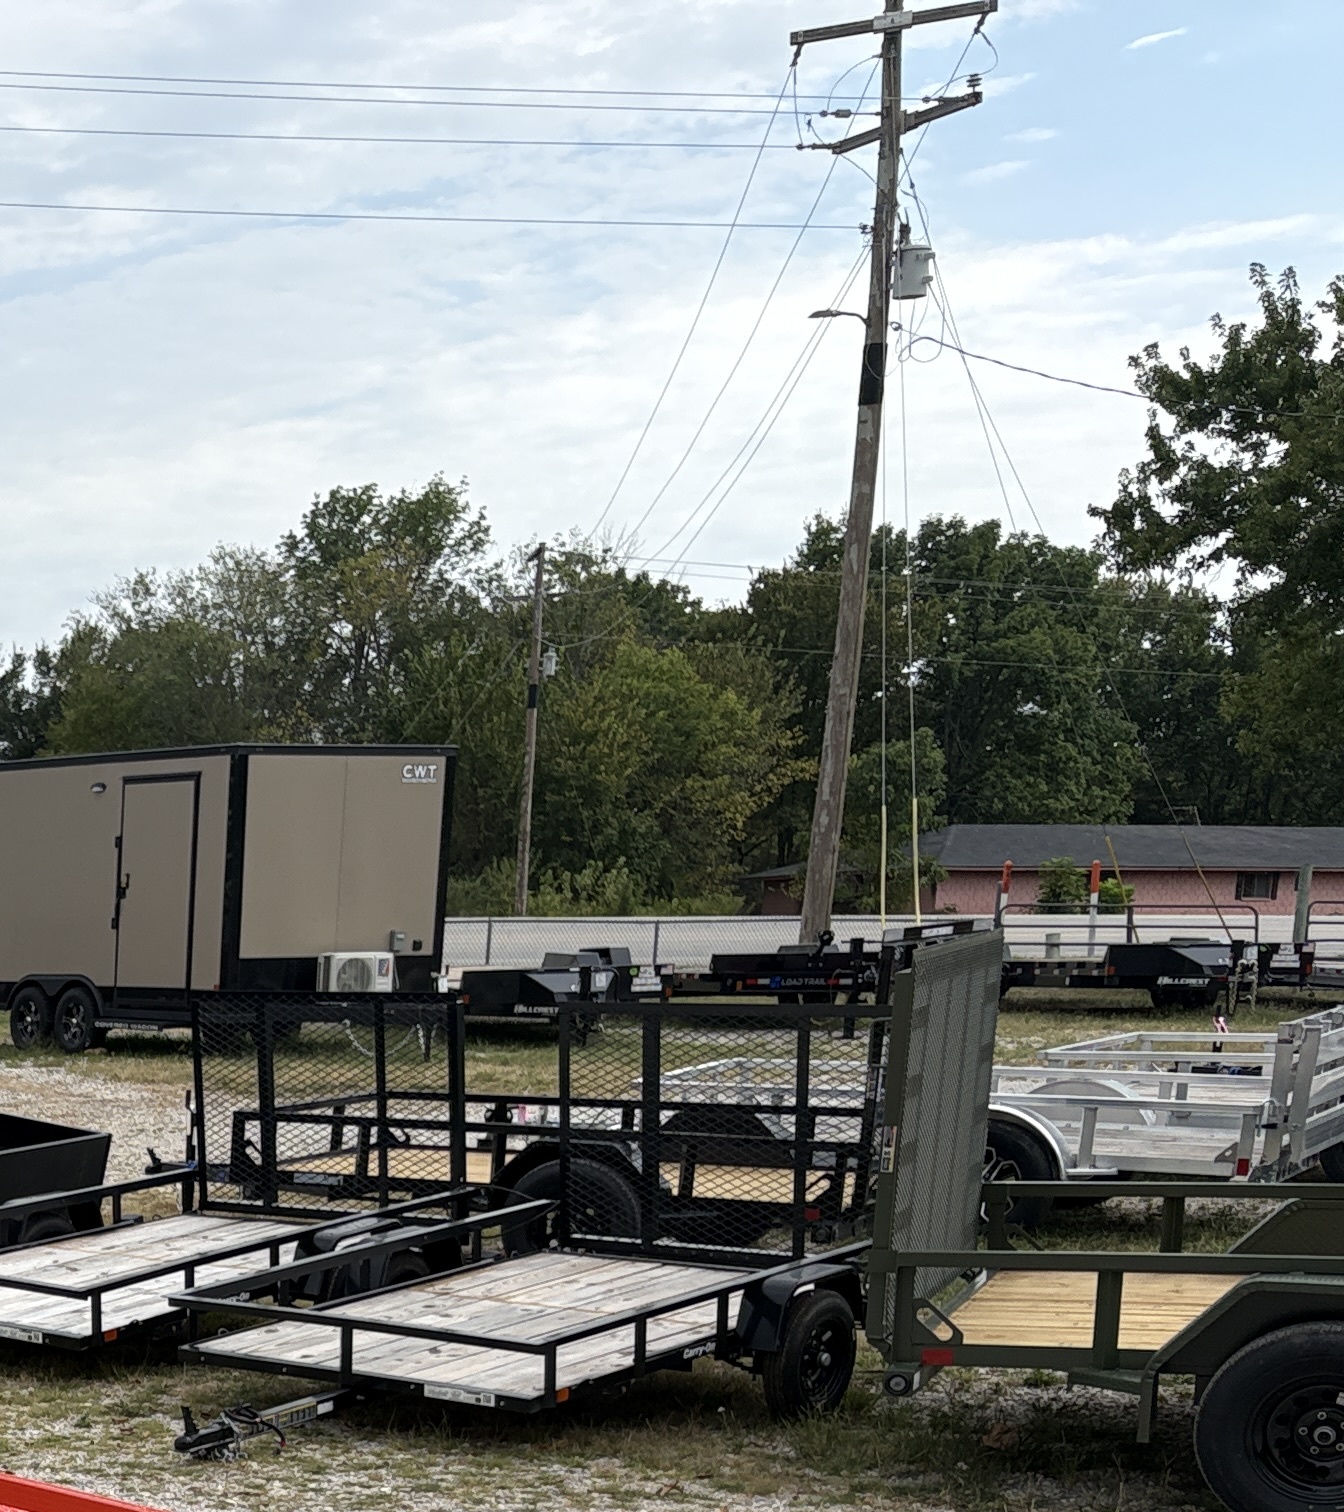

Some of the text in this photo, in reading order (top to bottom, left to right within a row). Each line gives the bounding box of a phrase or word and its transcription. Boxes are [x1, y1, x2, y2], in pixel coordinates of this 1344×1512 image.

[402, 764, 438, 779] CWT
[781, 977, 826, 986] LOAD TRAIL
[1156, 976, 1211, 986] HILLCREST
[514, 1003, 560, 1015] HILLCREST
